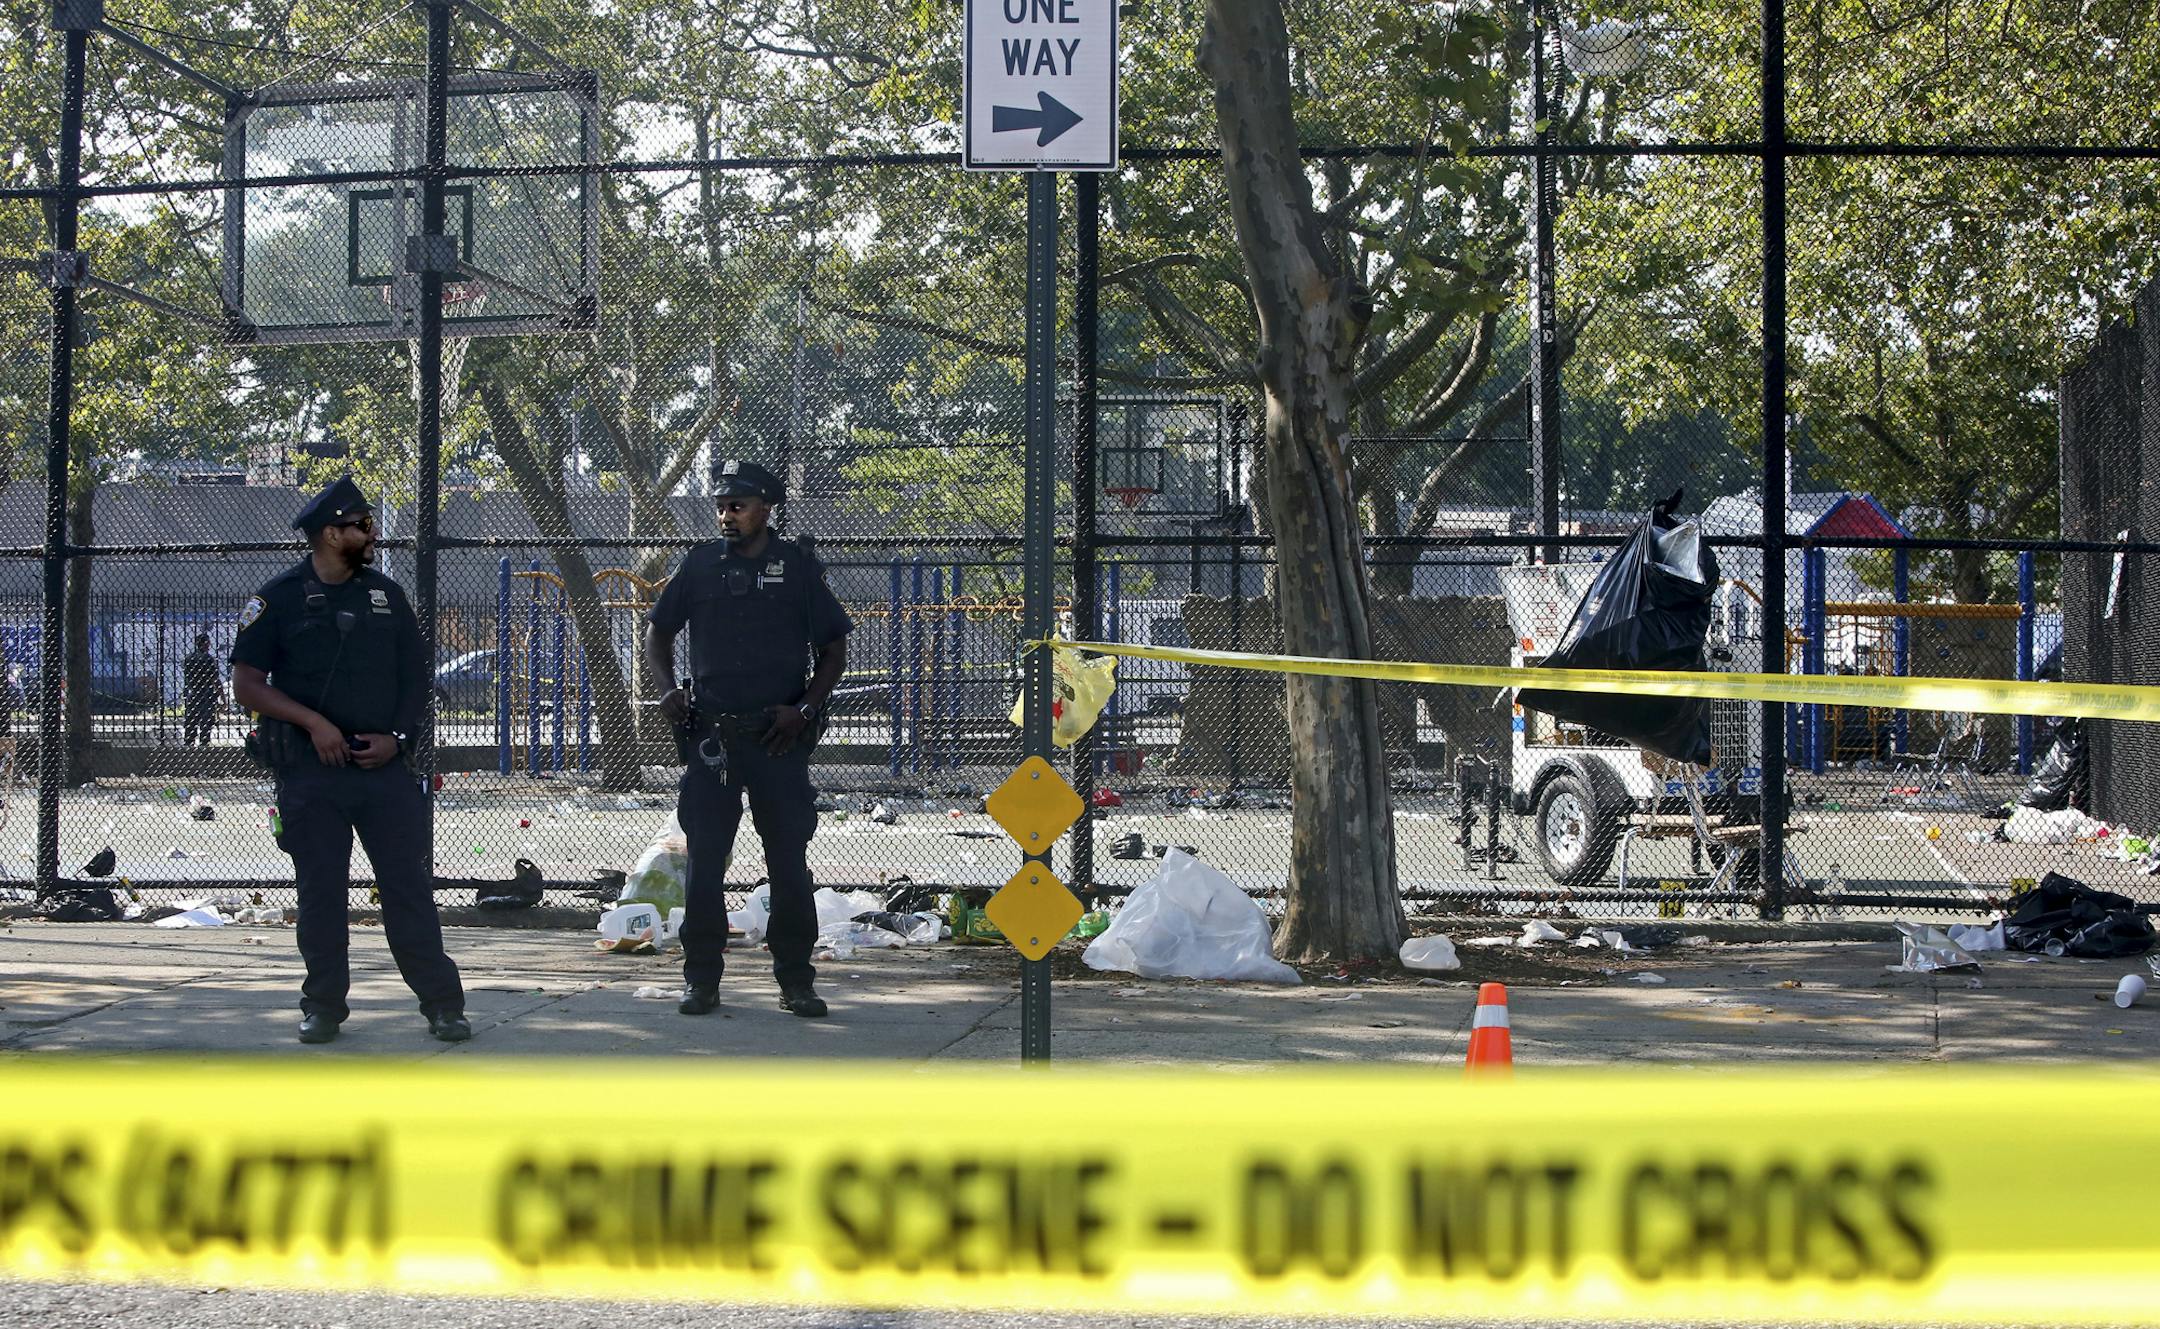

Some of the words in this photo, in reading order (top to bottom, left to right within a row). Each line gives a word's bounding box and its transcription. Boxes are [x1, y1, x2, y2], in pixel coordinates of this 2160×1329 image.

[1003, 0, 1080, 24] ONE
[1001, 38, 1081, 76] WAY
[494, 1154, 780, 1270] CRIME
[818, 1156, 1117, 1278] SCENE
[1241, 1156, 1368, 1280] DO
[1398, 1158, 1582, 1281] NOT
[1620, 1156, 1937, 1283] CROSS
